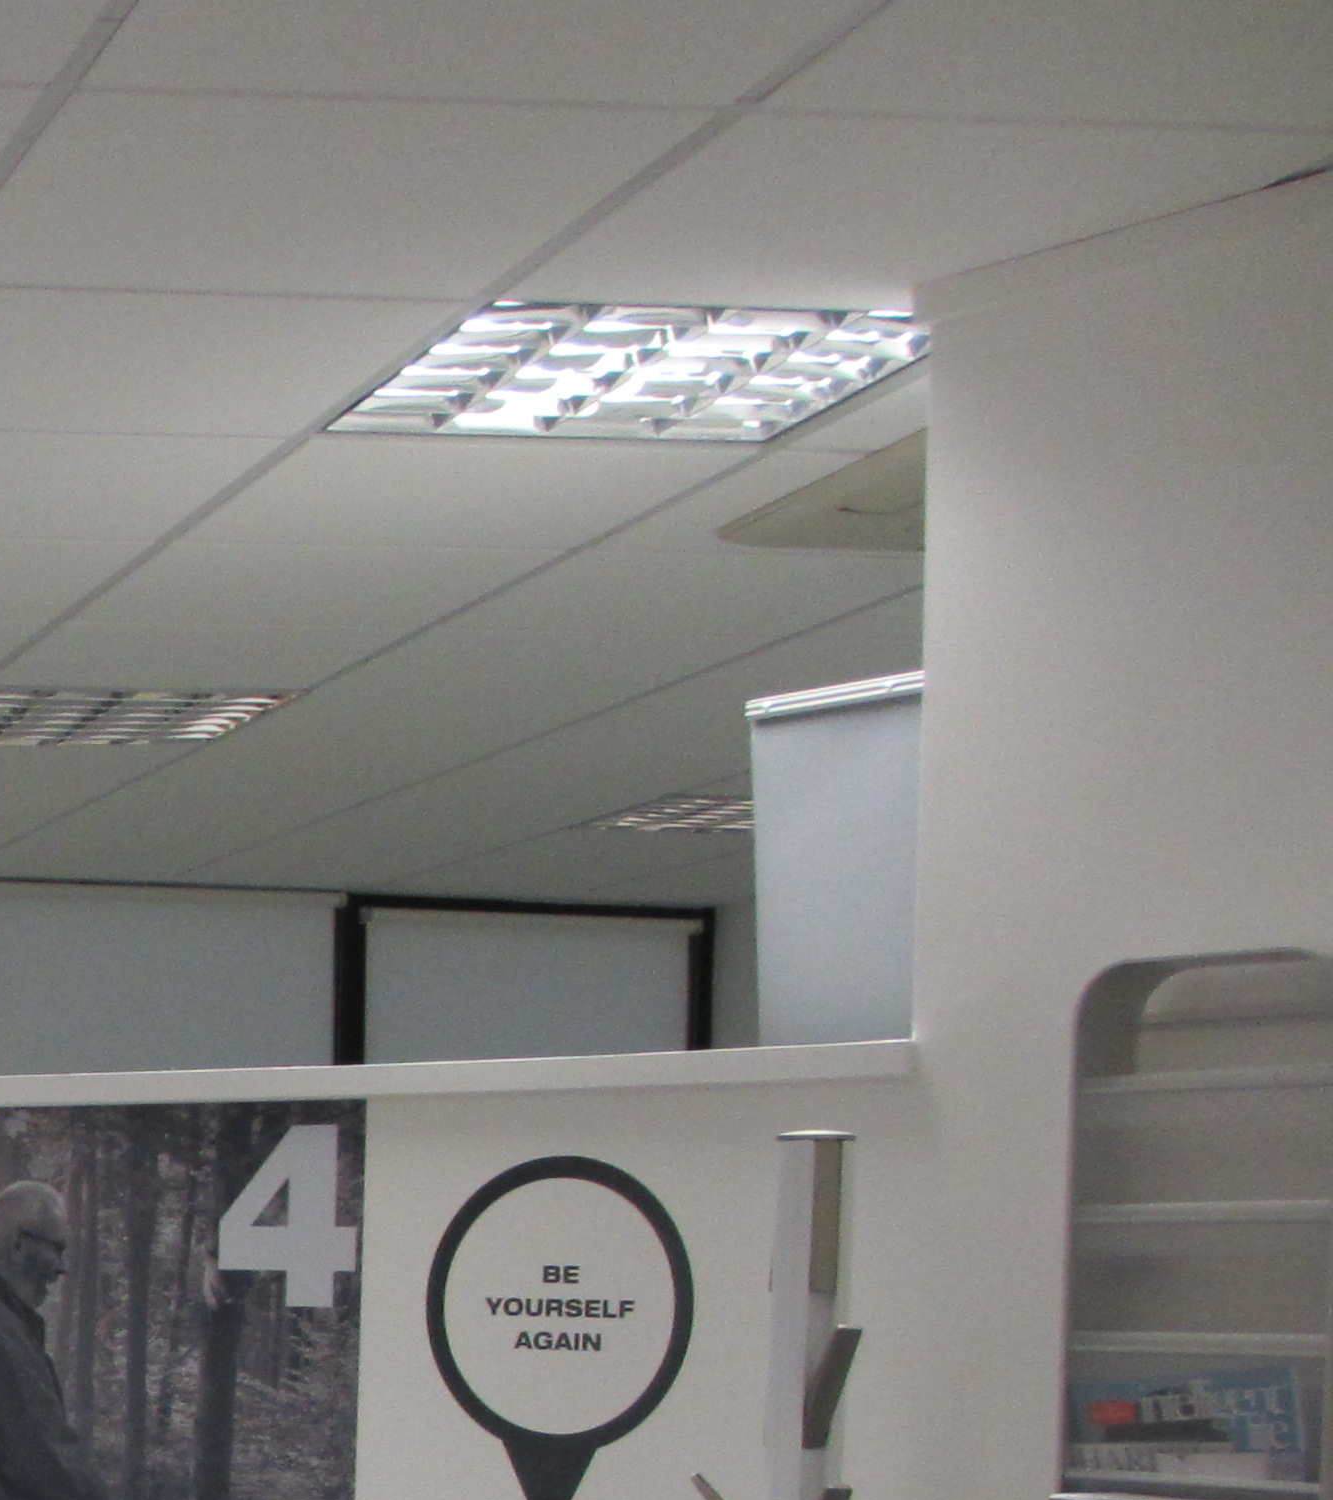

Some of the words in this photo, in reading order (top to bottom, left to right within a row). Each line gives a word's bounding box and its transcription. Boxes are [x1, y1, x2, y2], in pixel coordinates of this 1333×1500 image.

[217, 1125, 358, 1310] 4
[543, 1265, 579, 1284] BE
[487, 1298, 634, 1318] YOURSELF
[515, 1331, 601, 1351] AGAIN
